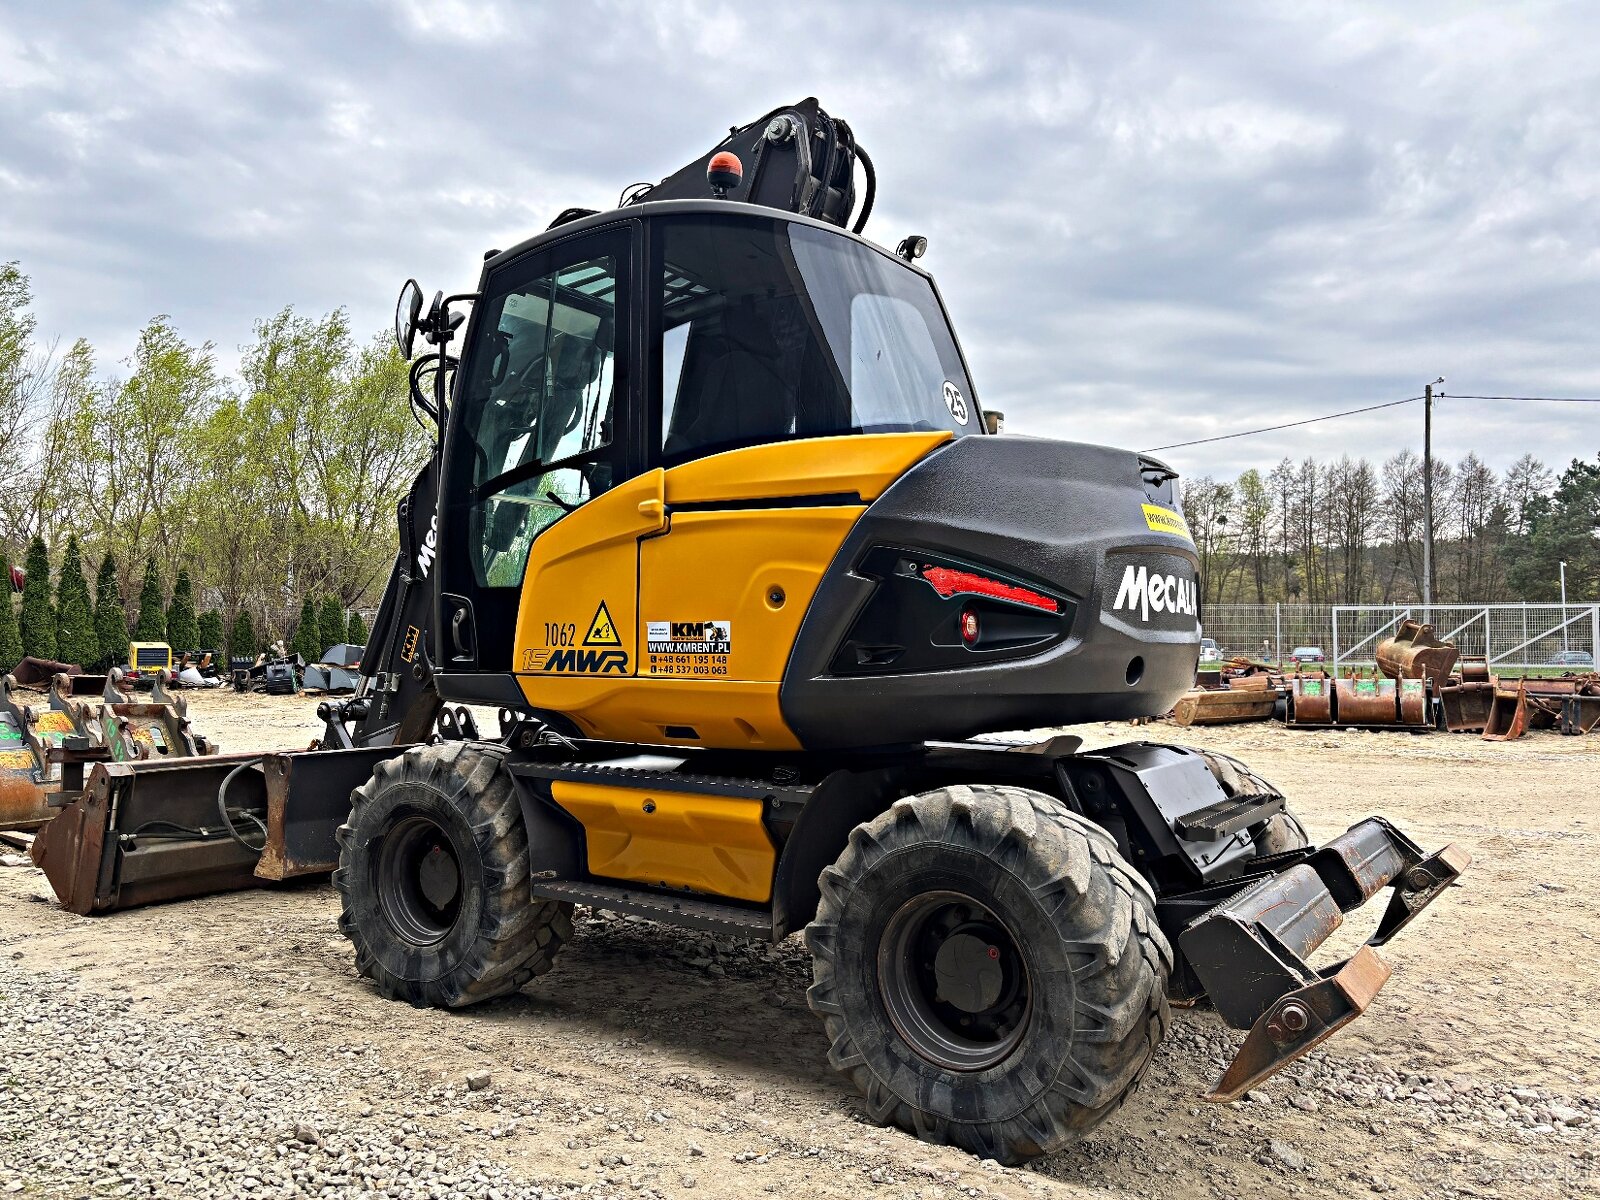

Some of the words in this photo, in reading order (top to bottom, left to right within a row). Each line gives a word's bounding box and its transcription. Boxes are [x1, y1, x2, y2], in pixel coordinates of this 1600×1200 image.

[945, 386, 966, 420] 25
[544, 622, 576, 647] 1062
[671, 622, 704, 637] KM
[648, 642, 730, 653] WWW.KMRENT.PL
[658, 655, 674, 664] +48
[675, 655, 691, 664] 661
[693, 655, 709, 664] 195
[711, 655, 727, 664] 148
[658, 665, 674, 674] +48
[675, 665, 691, 674] 537
[693, 665, 709, 675] 003
[711, 665, 727, 675] 063
